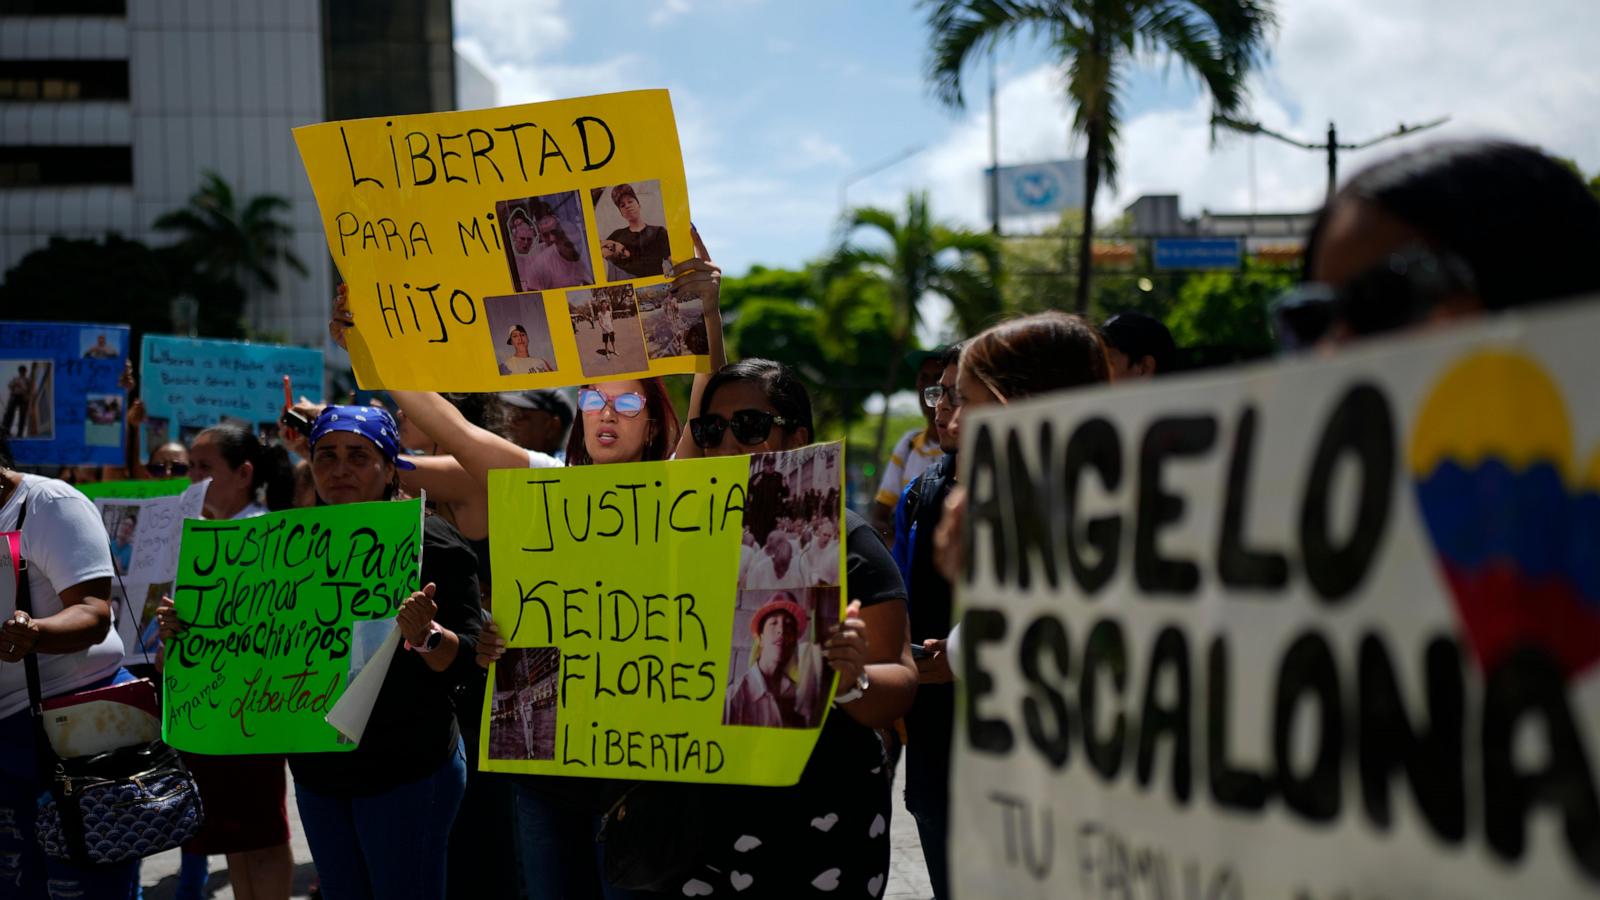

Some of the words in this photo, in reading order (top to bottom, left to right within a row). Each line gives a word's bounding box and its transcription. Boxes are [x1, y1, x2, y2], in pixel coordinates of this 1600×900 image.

[335, 211, 433, 260] PARA
[964, 379, 1396, 608] ANGELO
[191, 518, 341, 578] Justicia
[342, 523, 419, 579] Para
[175, 570, 316, 629] Ildemar
[229, 667, 341, 738] Libertad
[561, 652, 716, 708] FLORES
[962, 606, 1600, 886] ESCALONA
[987, 792, 1055, 881] TU
